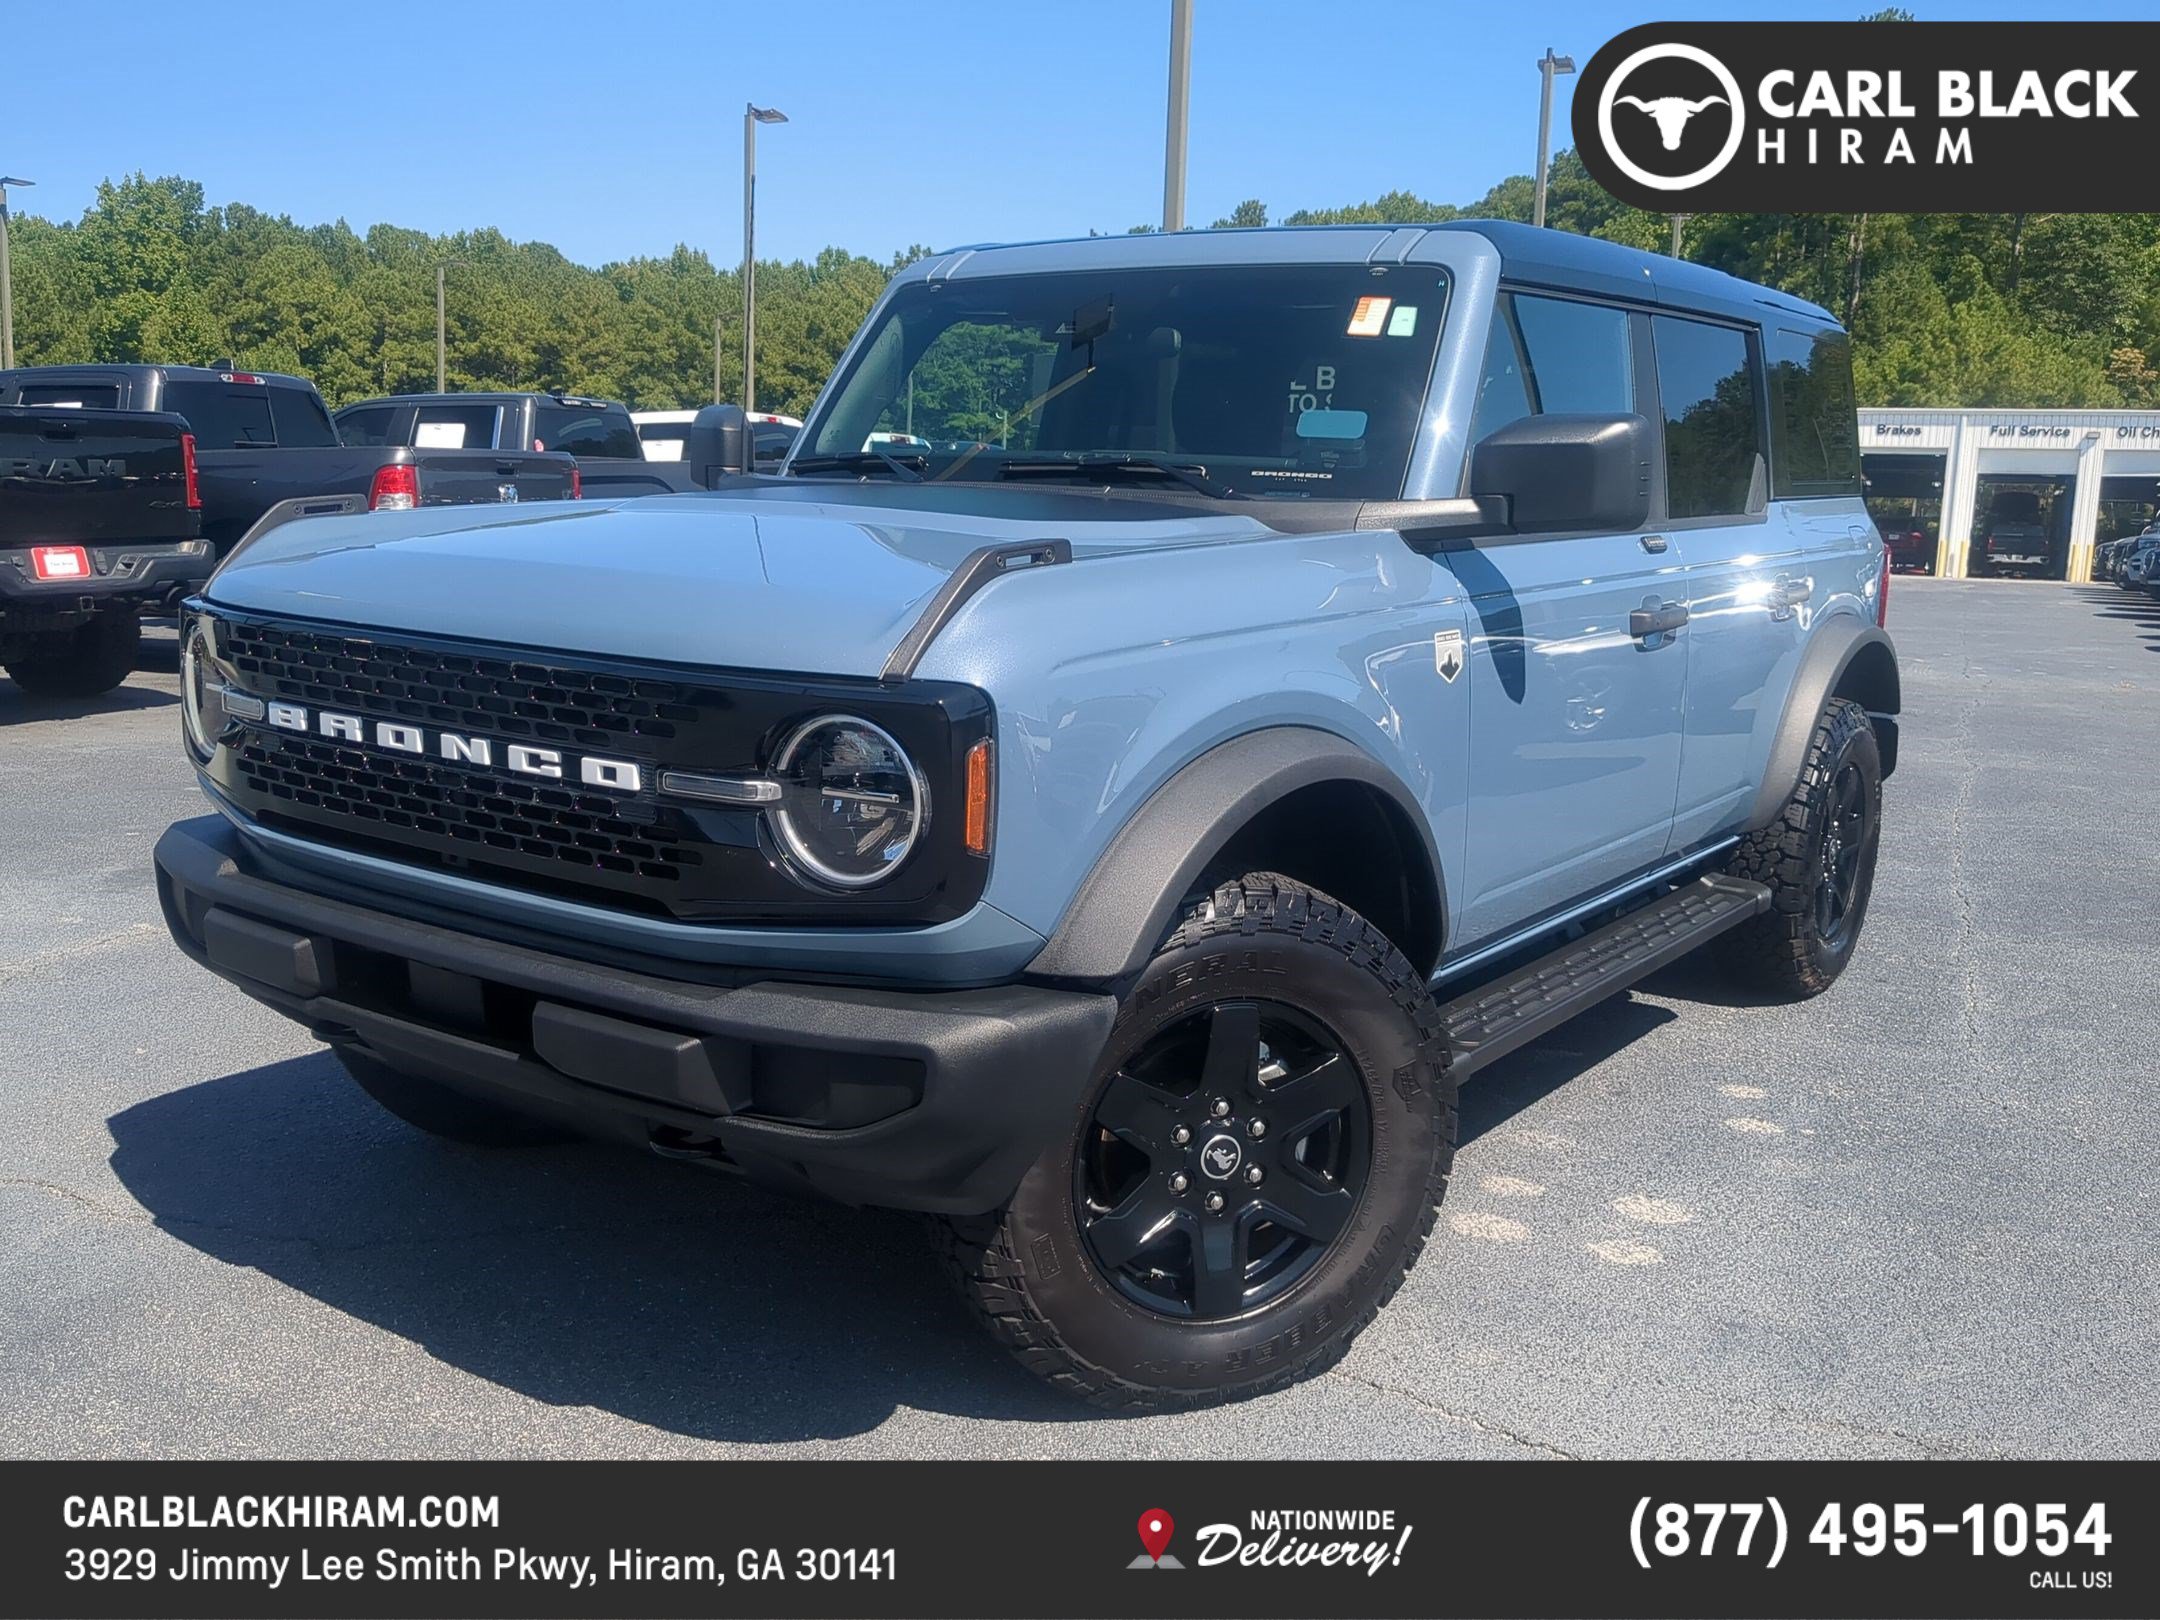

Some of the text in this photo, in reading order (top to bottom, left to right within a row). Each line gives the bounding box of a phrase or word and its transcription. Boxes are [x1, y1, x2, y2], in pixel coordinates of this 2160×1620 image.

[1876, 424, 1922, 436] Brakes
[1990, 425, 2071, 438] Full Service
[2117, 426, 2137, 438] Oil
[0, 457, 127, 477] RAM
[268, 702, 641, 791] BRONCO
